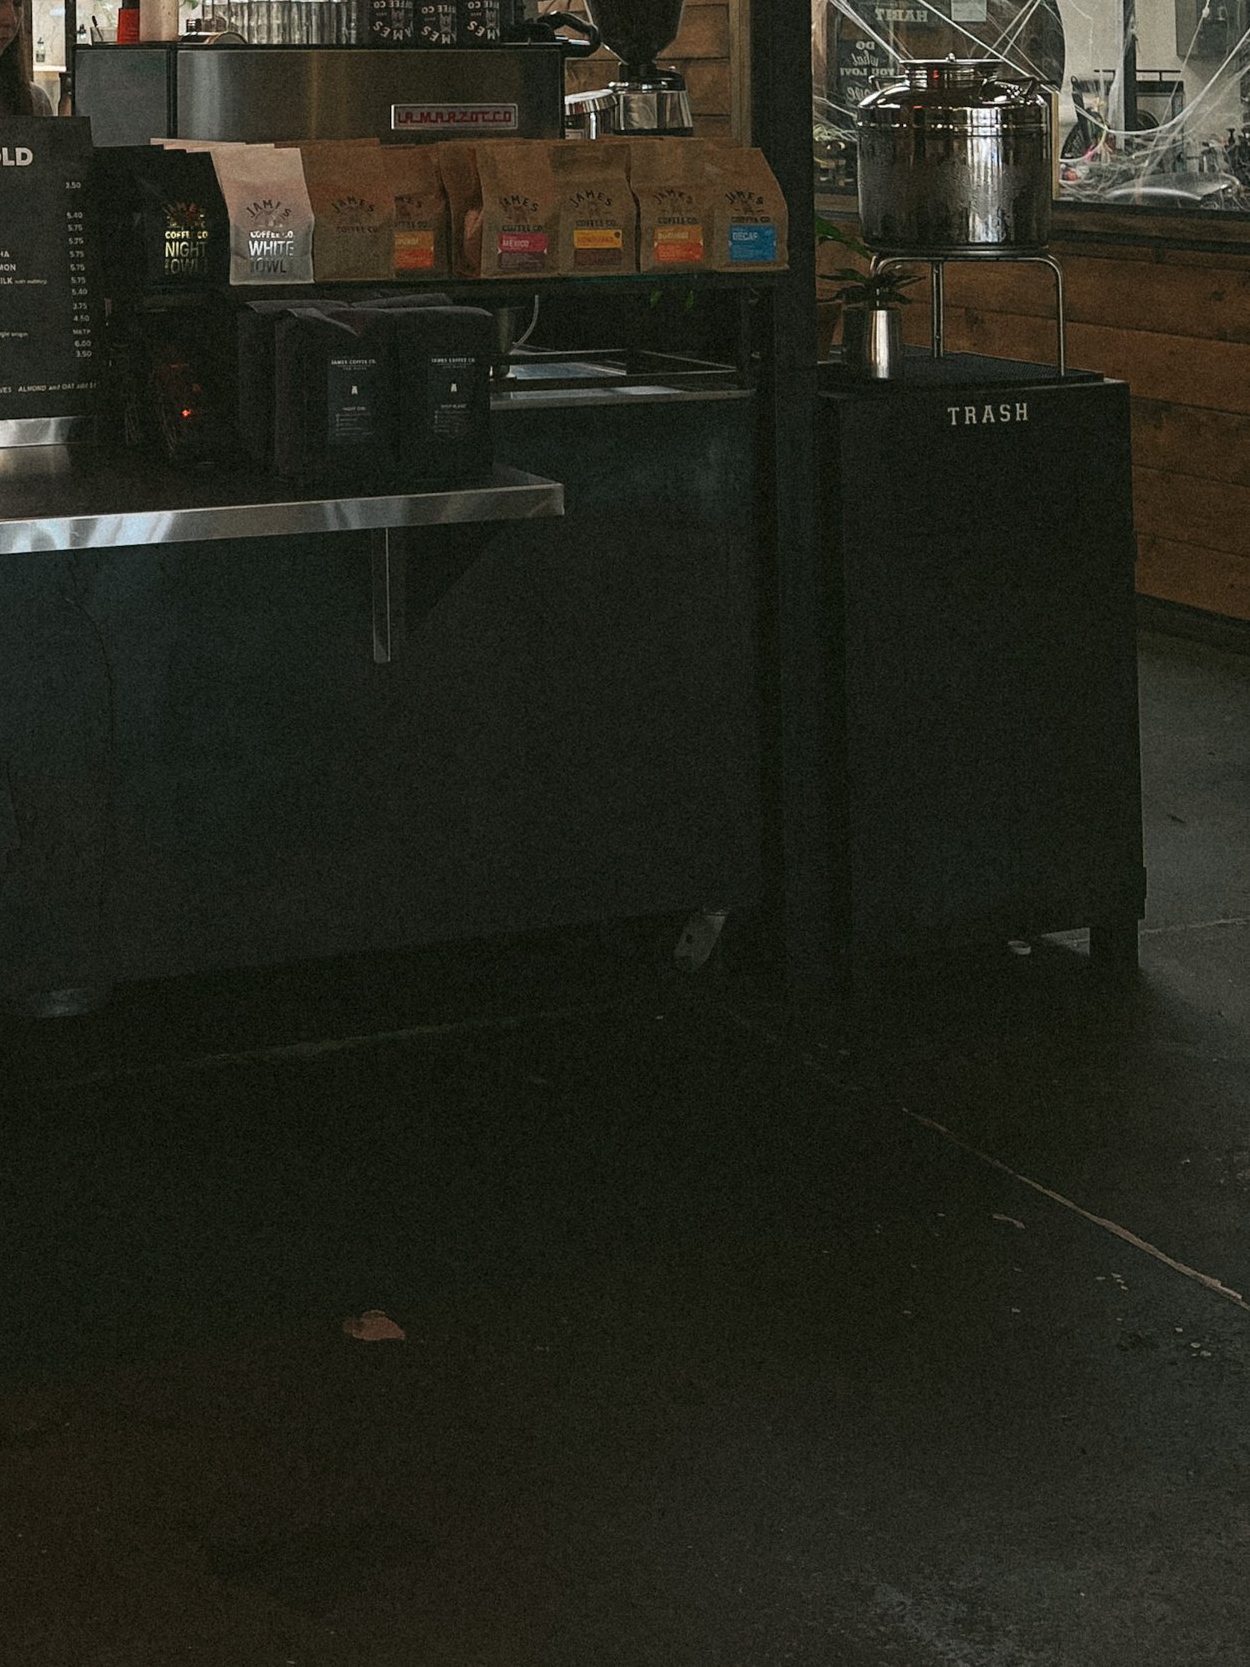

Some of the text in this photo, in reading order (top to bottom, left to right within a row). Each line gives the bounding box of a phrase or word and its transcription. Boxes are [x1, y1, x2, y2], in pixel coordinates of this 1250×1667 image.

[570, 190, 612, 208] JAMES
[165, 241, 207, 258] NIGHT
[248, 240, 295, 256] WHITE
[947, 402, 1029, 426] TRASH
